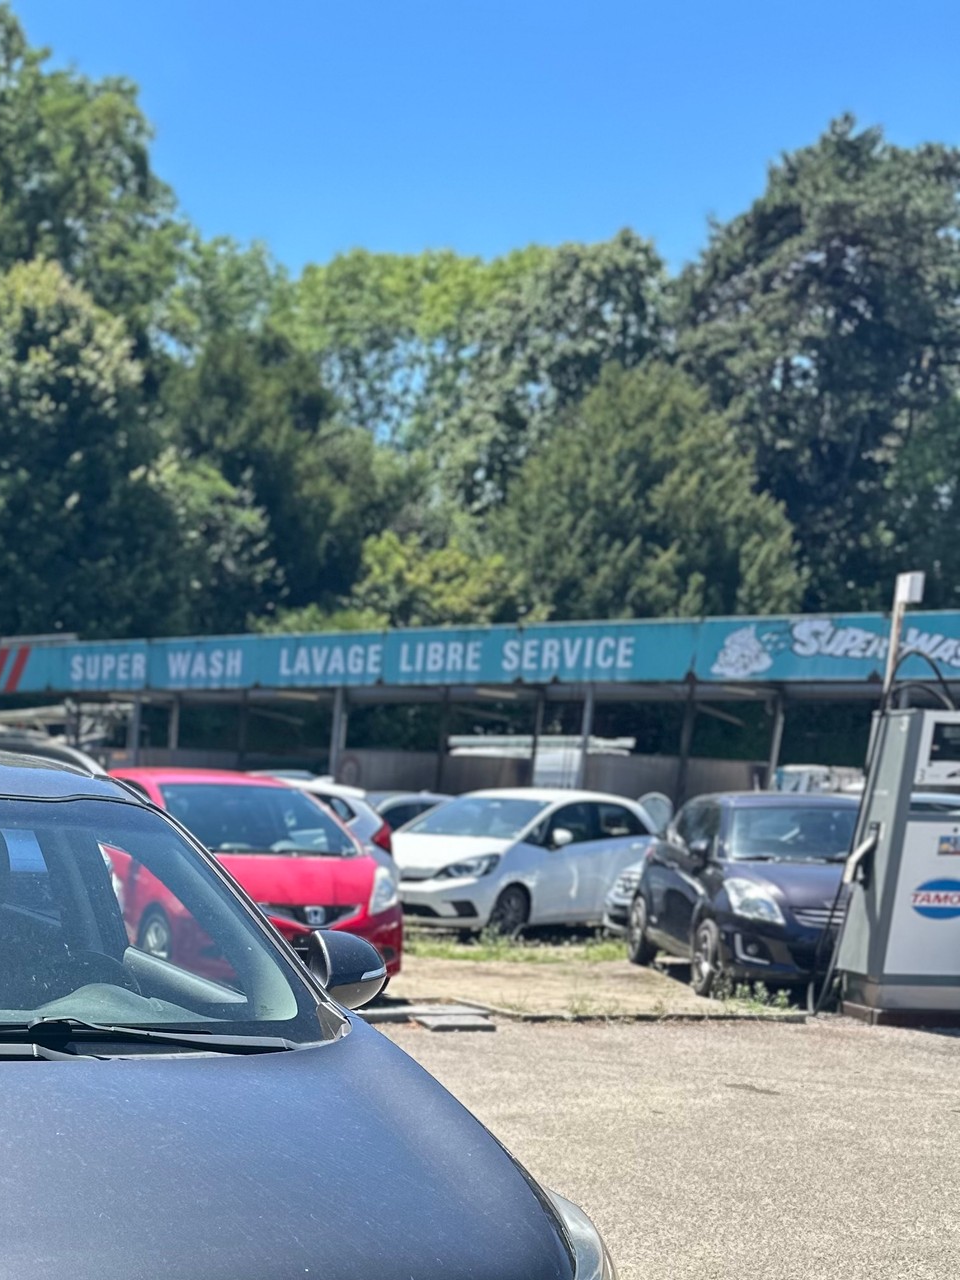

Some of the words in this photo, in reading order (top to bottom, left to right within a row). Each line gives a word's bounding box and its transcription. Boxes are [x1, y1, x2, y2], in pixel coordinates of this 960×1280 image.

[70, 652, 147, 682] SUPER
[168, 650, 243, 679] WASH
[279, 644, 383, 676] LAVAGE
[399, 641, 482, 672] LIBRE
[501, 636, 635, 671] SERVICE
